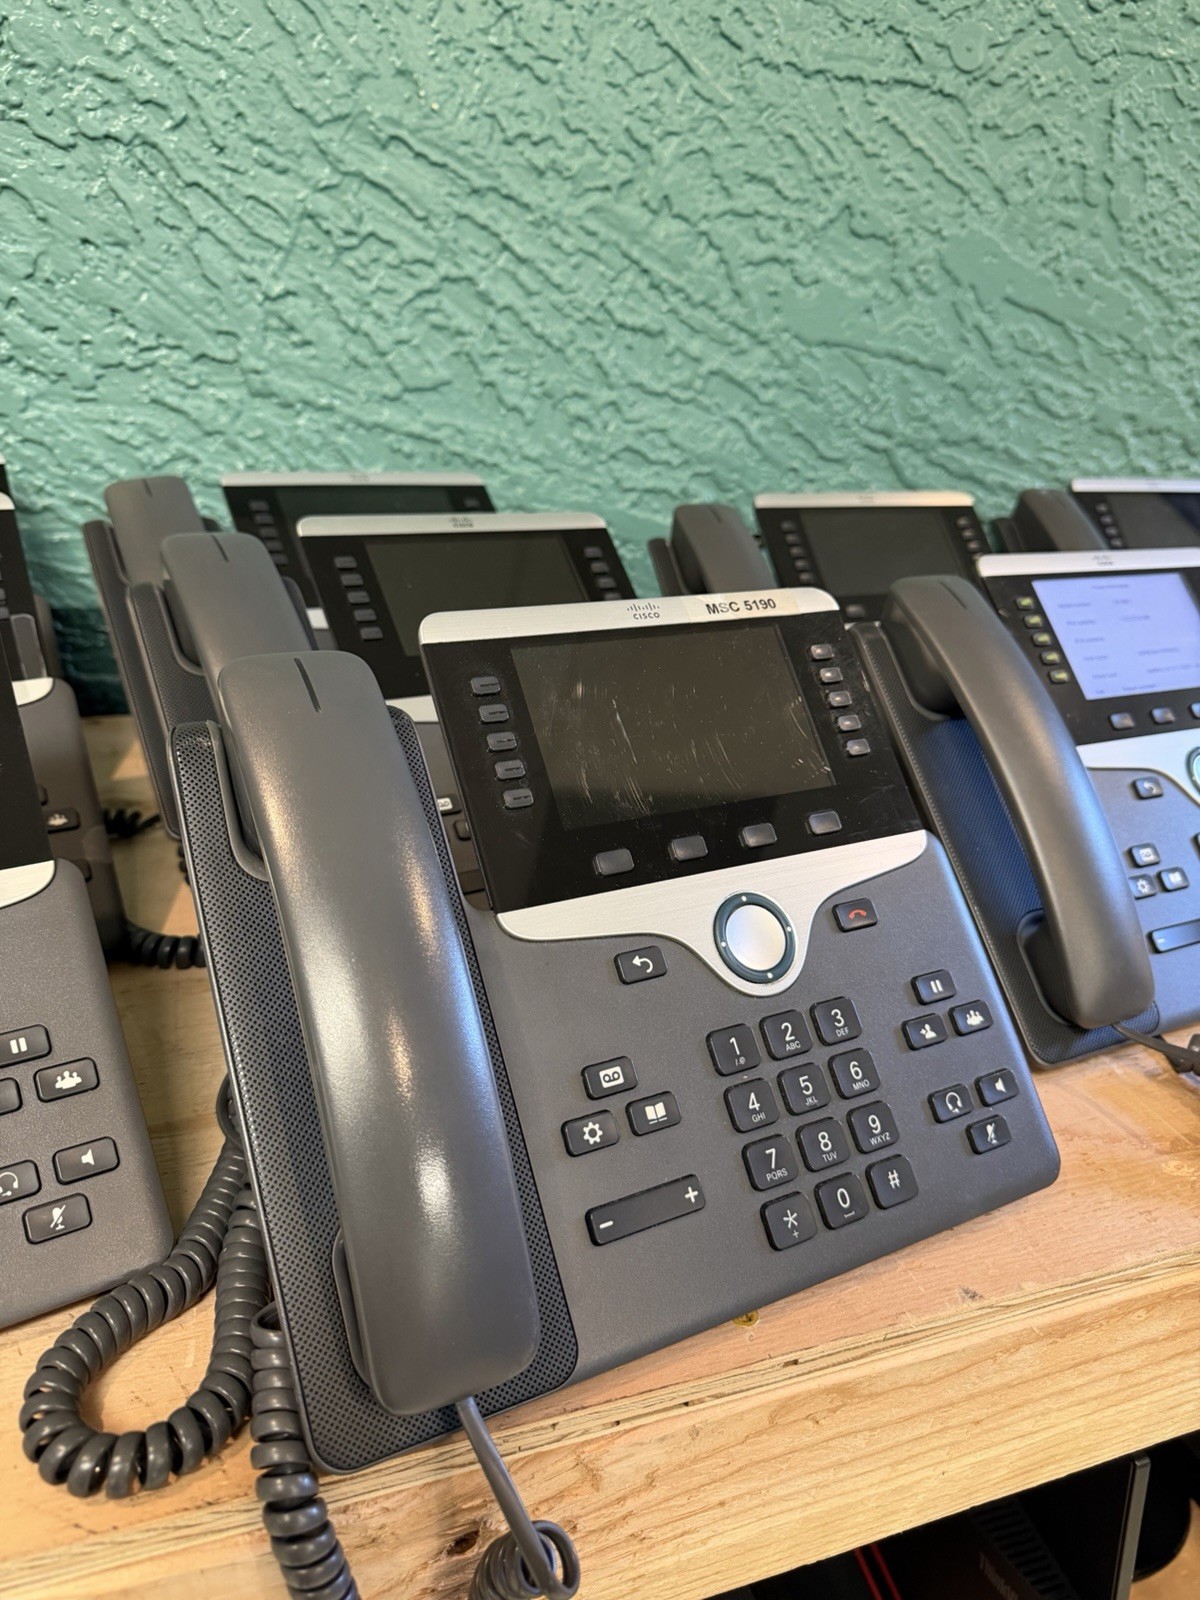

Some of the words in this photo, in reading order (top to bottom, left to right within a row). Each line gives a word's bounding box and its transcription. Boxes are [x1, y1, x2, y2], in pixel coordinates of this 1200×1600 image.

[633, 611, 661, 620] CISCO
[706, 601, 740, 615] MSC
[744, 598, 777, 611] 5190
[831, 1009, 845, 1028] 3
[781, 1022, 796, 1041] 2
[836, 1028, 850, 1037] DEF
[729, 1037, 740, 1055] 1
[786, 1040, 801, 1051] ABC
[850, 1061, 864, 1080] 6
[799, 1075, 813, 1095] 5
[852, 1079, 870, 1091] MNO
[748, 1092, 761, 1111] 4
[751, 1112, 766, 1123] GHI
[868, 1114, 881, 1134] 9
[818, 1131, 832, 1151] 8
[869, 1131, 891, 1146] WXYZ
[765, 1148, 777, 1169] 7
[822, 1151, 837, 1163] TUV
[766, 1167, 788, 1182] PQRS
[836, 1188, 850, 1208] 0
